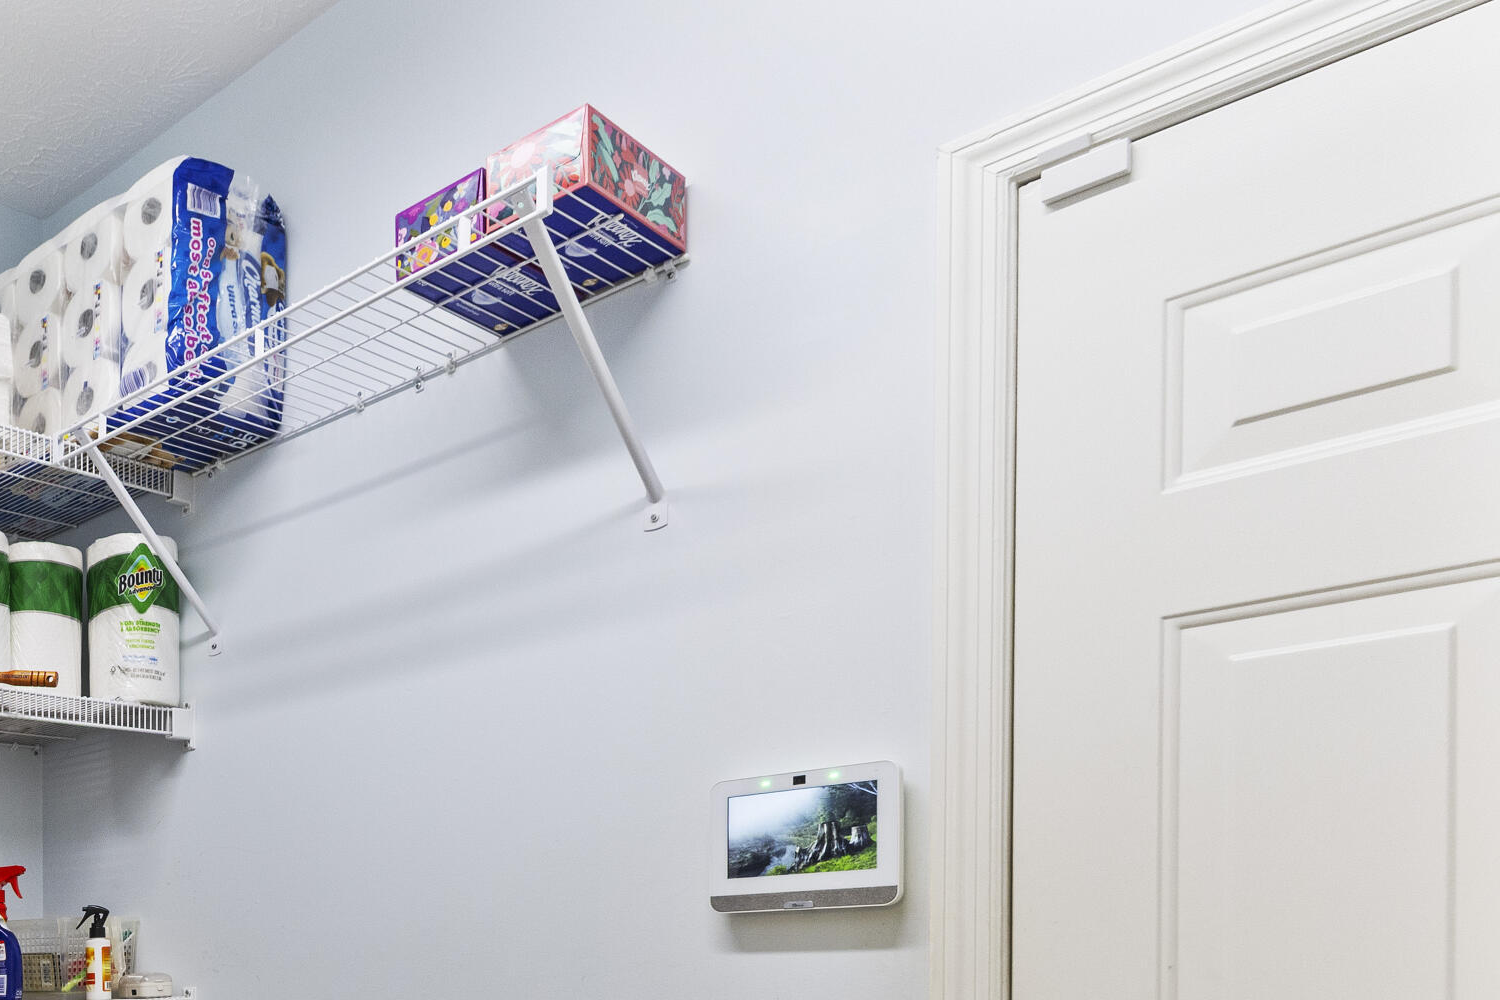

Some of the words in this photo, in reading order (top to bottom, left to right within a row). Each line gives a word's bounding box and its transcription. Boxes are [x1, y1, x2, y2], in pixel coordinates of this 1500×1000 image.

[188, 217, 202, 277] most
[227, 285, 239, 319] Ultra
[184, 278, 202, 380] absorbet
[118, 567, 163, 595] Bounty
[128, 584, 157, 595] Advanced
